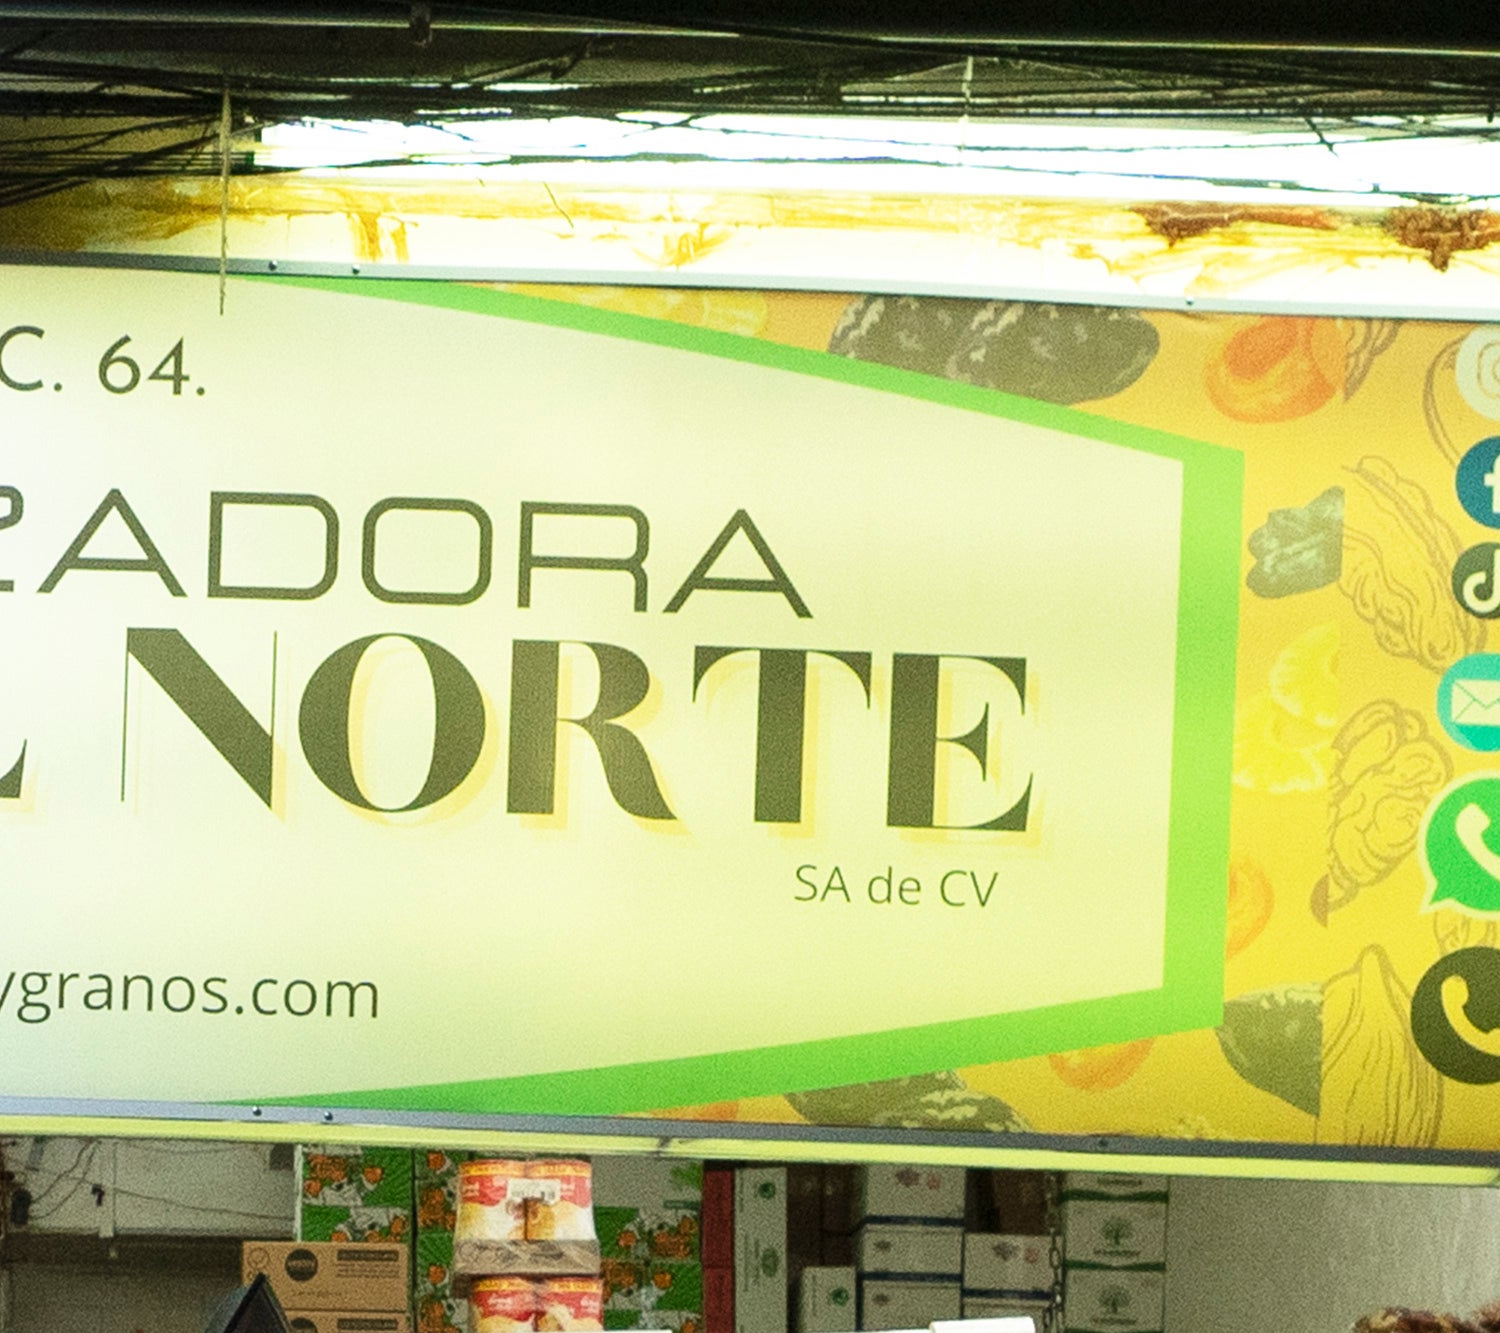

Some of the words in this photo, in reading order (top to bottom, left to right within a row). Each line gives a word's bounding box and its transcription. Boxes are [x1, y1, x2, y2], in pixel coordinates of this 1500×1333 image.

[97, 334, 207, 397] 64.
[121, 627, 1033, 835] NORTE
[794, 865, 851, 903] SA
[867, 865, 921, 906] de
[938, 869, 999, 909] CV
